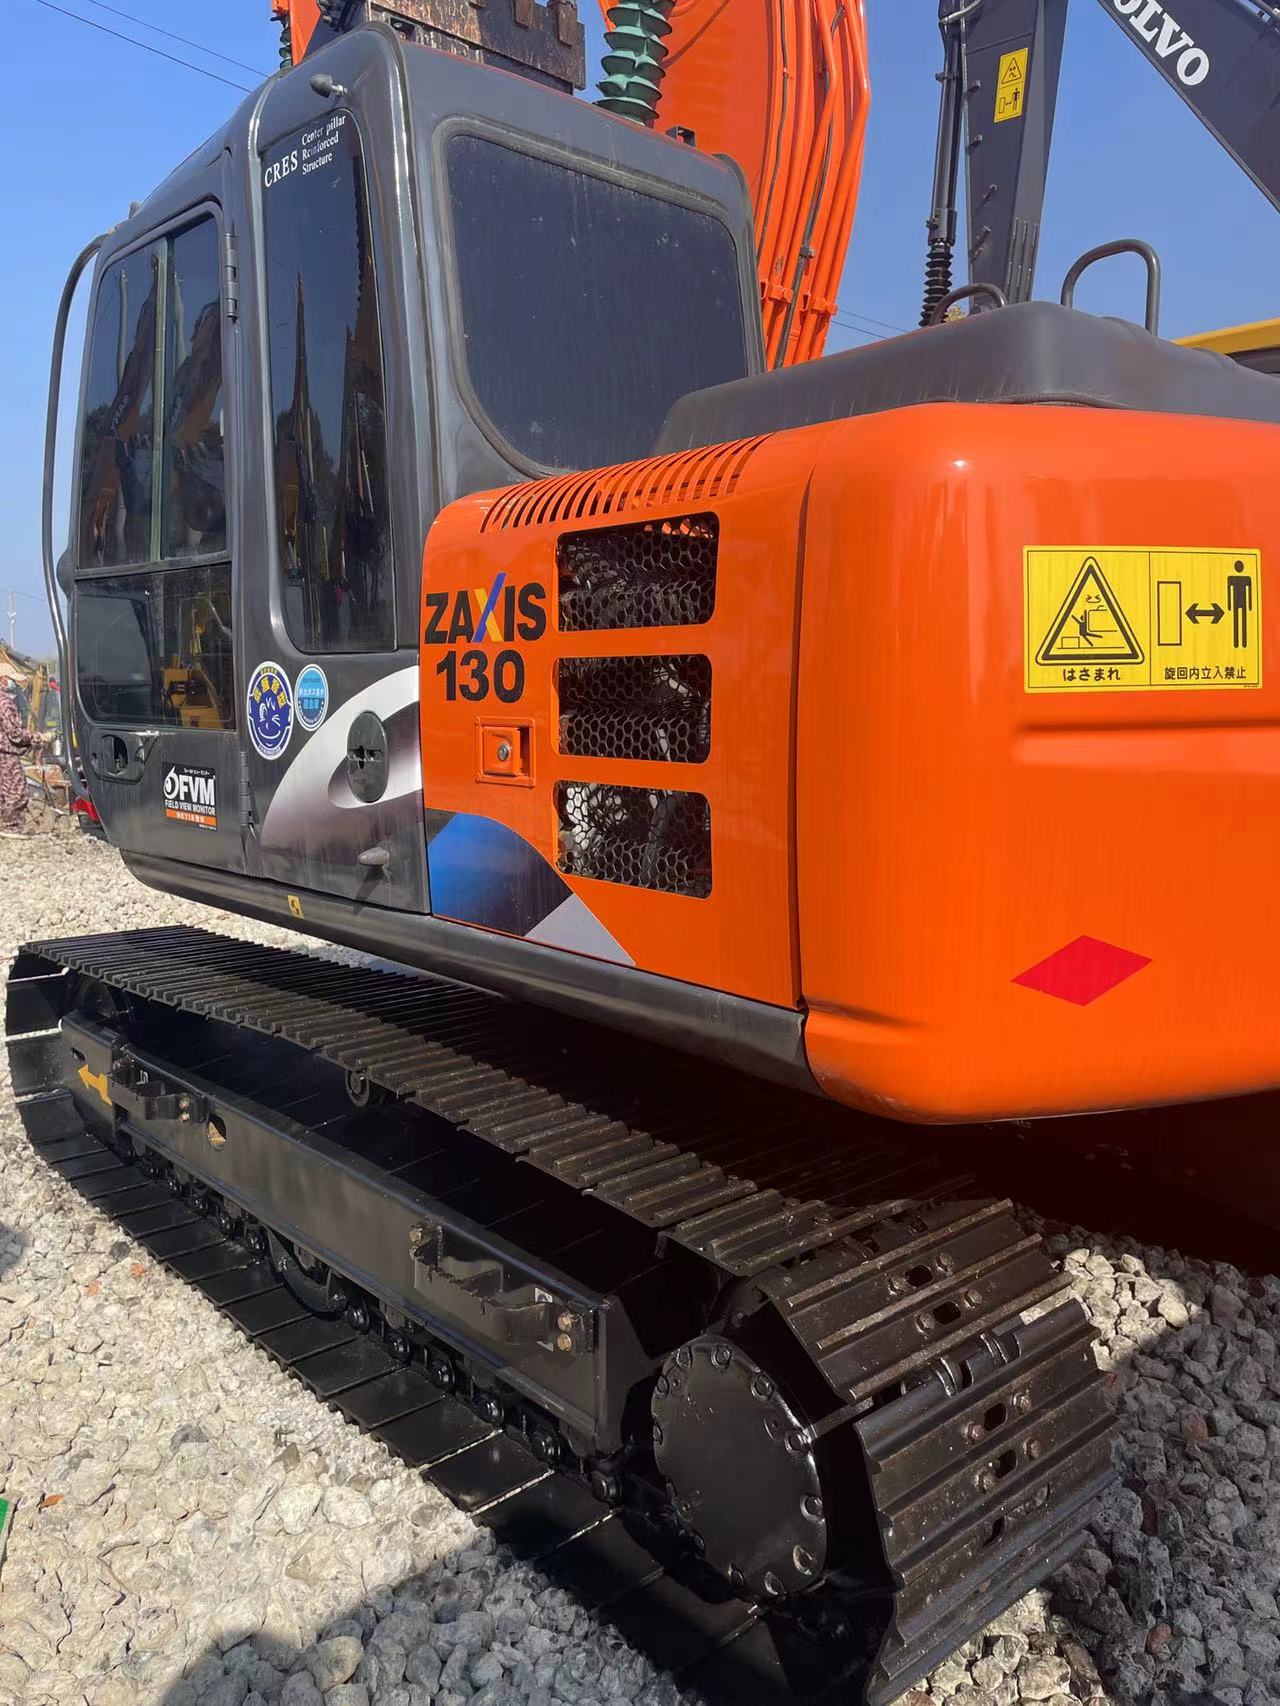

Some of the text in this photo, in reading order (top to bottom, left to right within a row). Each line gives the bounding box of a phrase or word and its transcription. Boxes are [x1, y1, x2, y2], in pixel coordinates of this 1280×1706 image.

[302, 115, 346, 146] Center pillar
[302, 131, 339, 161] Reinforced
[264, 150, 298, 188] CRES
[302, 152, 333, 175] Structure
[424, 571, 547, 644] ZAXIS
[436, 649, 525, 703] 130
[1062, 667, 1121, 682] はさまれ
[1164, 666, 1247, 681] 旋回内立入禁止
[179, 774, 215, 806] FVM
[164, 799, 216, 816] FIELD VIEW MONITOR
